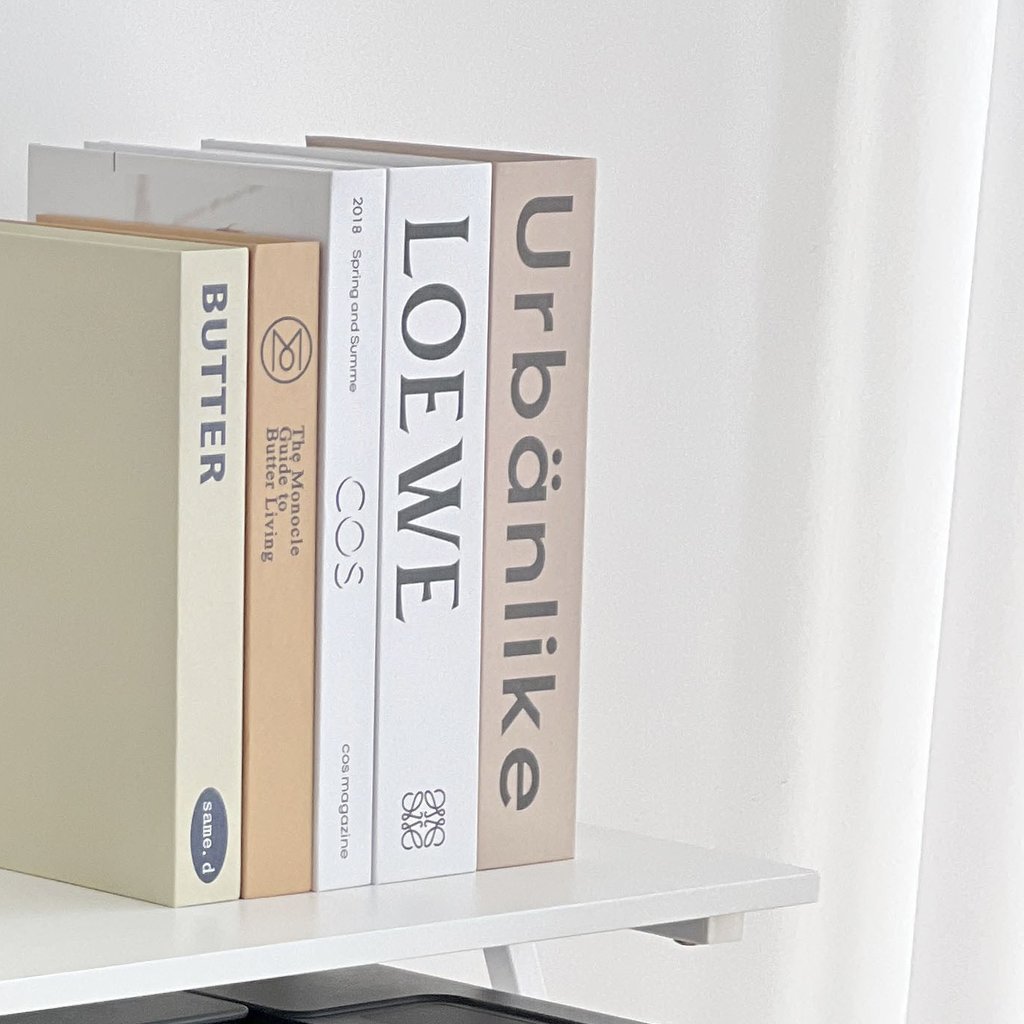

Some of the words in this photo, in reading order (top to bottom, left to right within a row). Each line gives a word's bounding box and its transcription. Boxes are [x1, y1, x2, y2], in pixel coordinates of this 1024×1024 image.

[352, 197, 363, 234] 2018
[349, 249, 362, 299] Spring
[350, 302, 360, 332] and
[199, 283, 228, 485] BUTTER
[349, 335, 360, 393] Summe
[291, 425, 305, 462] The
[396, 216, 469, 623] LOEWE
[265, 428, 279, 490] Butter
[278, 426, 292, 486] Guide
[261, 498, 278, 562] Living
[278, 493, 288, 512] to
[290, 470, 305, 556] Monocle
[334, 476, 365, 589] COS
[499, 195, 574, 811] Urbänlike
[341, 743, 351, 774] cos
[338, 777, 351, 859] magazine
